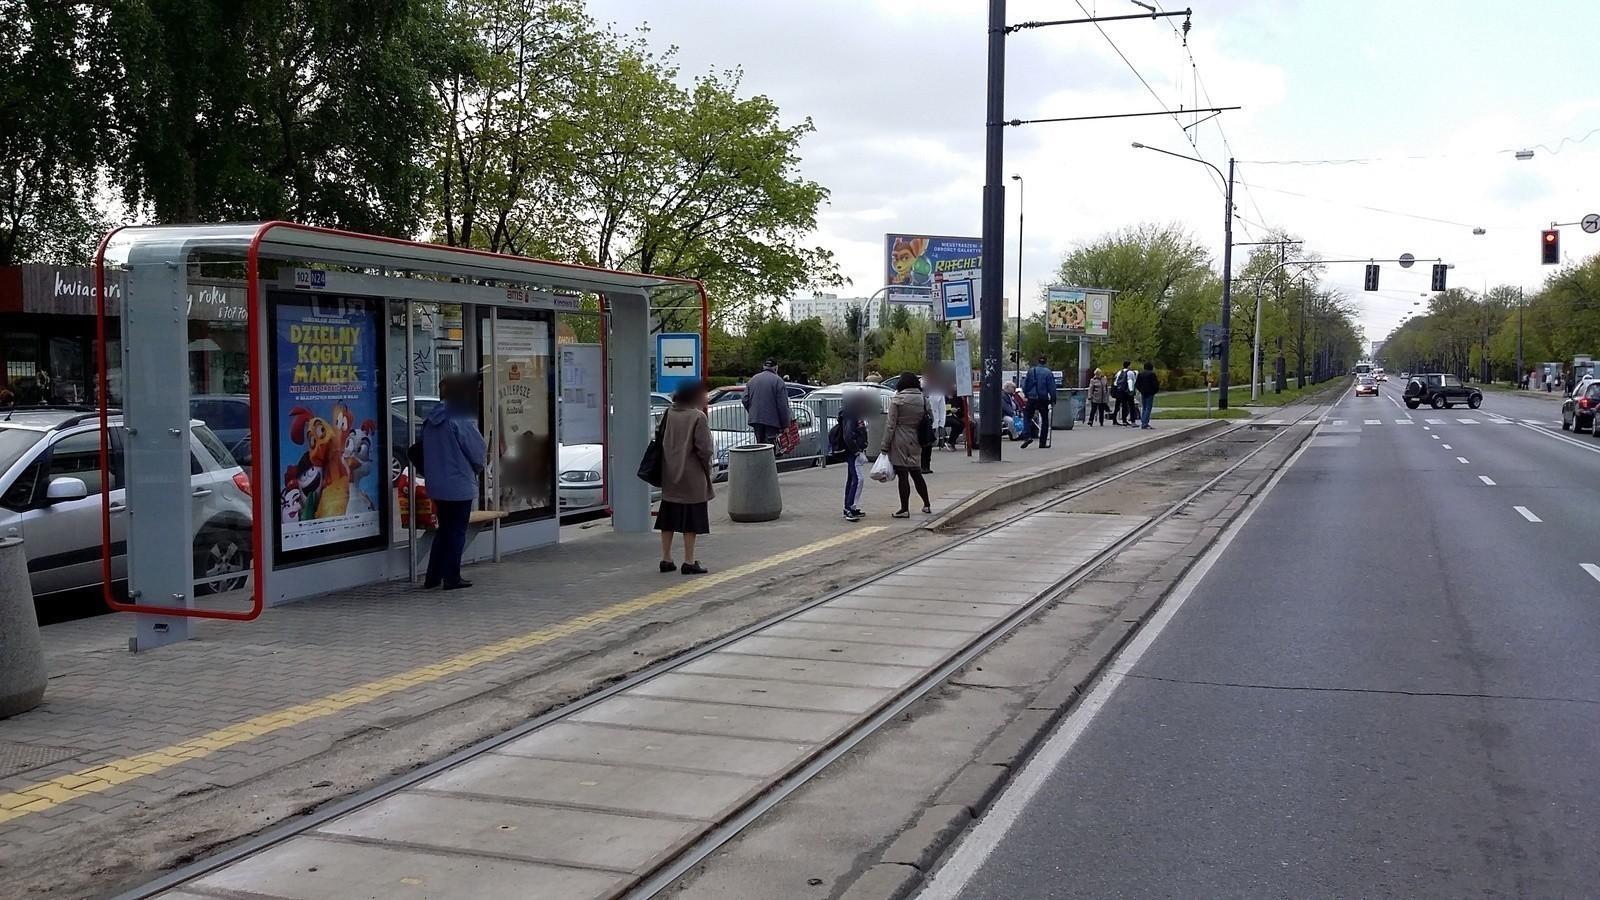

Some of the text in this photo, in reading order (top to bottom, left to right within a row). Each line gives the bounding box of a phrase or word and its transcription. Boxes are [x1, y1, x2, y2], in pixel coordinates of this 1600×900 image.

[297, 271, 325, 284] 102 N24
[199, 286, 227, 304] roku
[291, 325, 360, 344] DZIELNY
[298, 345, 354, 364] KOGUT
[293, 364, 359, 383] MANIEK
